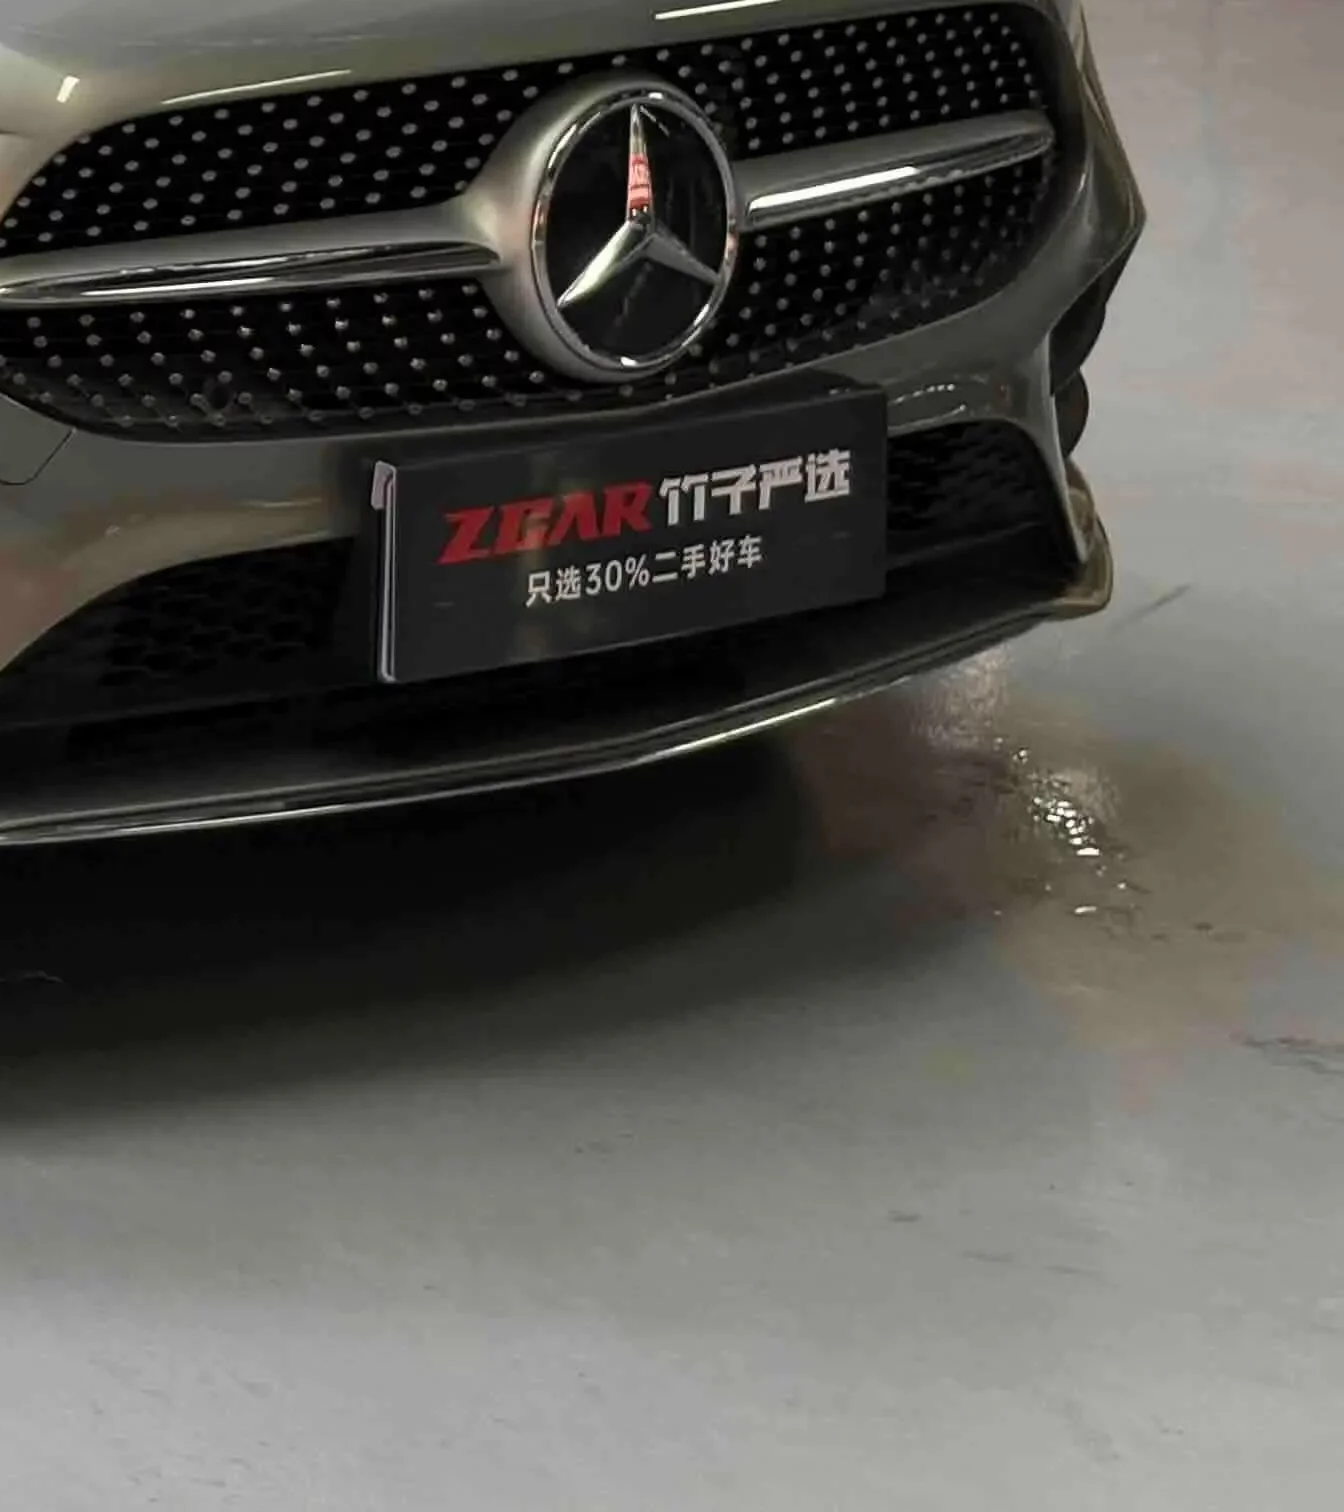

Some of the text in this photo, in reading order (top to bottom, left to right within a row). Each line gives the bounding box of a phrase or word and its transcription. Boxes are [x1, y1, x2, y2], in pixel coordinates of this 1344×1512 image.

[659, 448, 852, 526] 竹子严选
[525, 534, 763, 608] 只选30%二手好车
